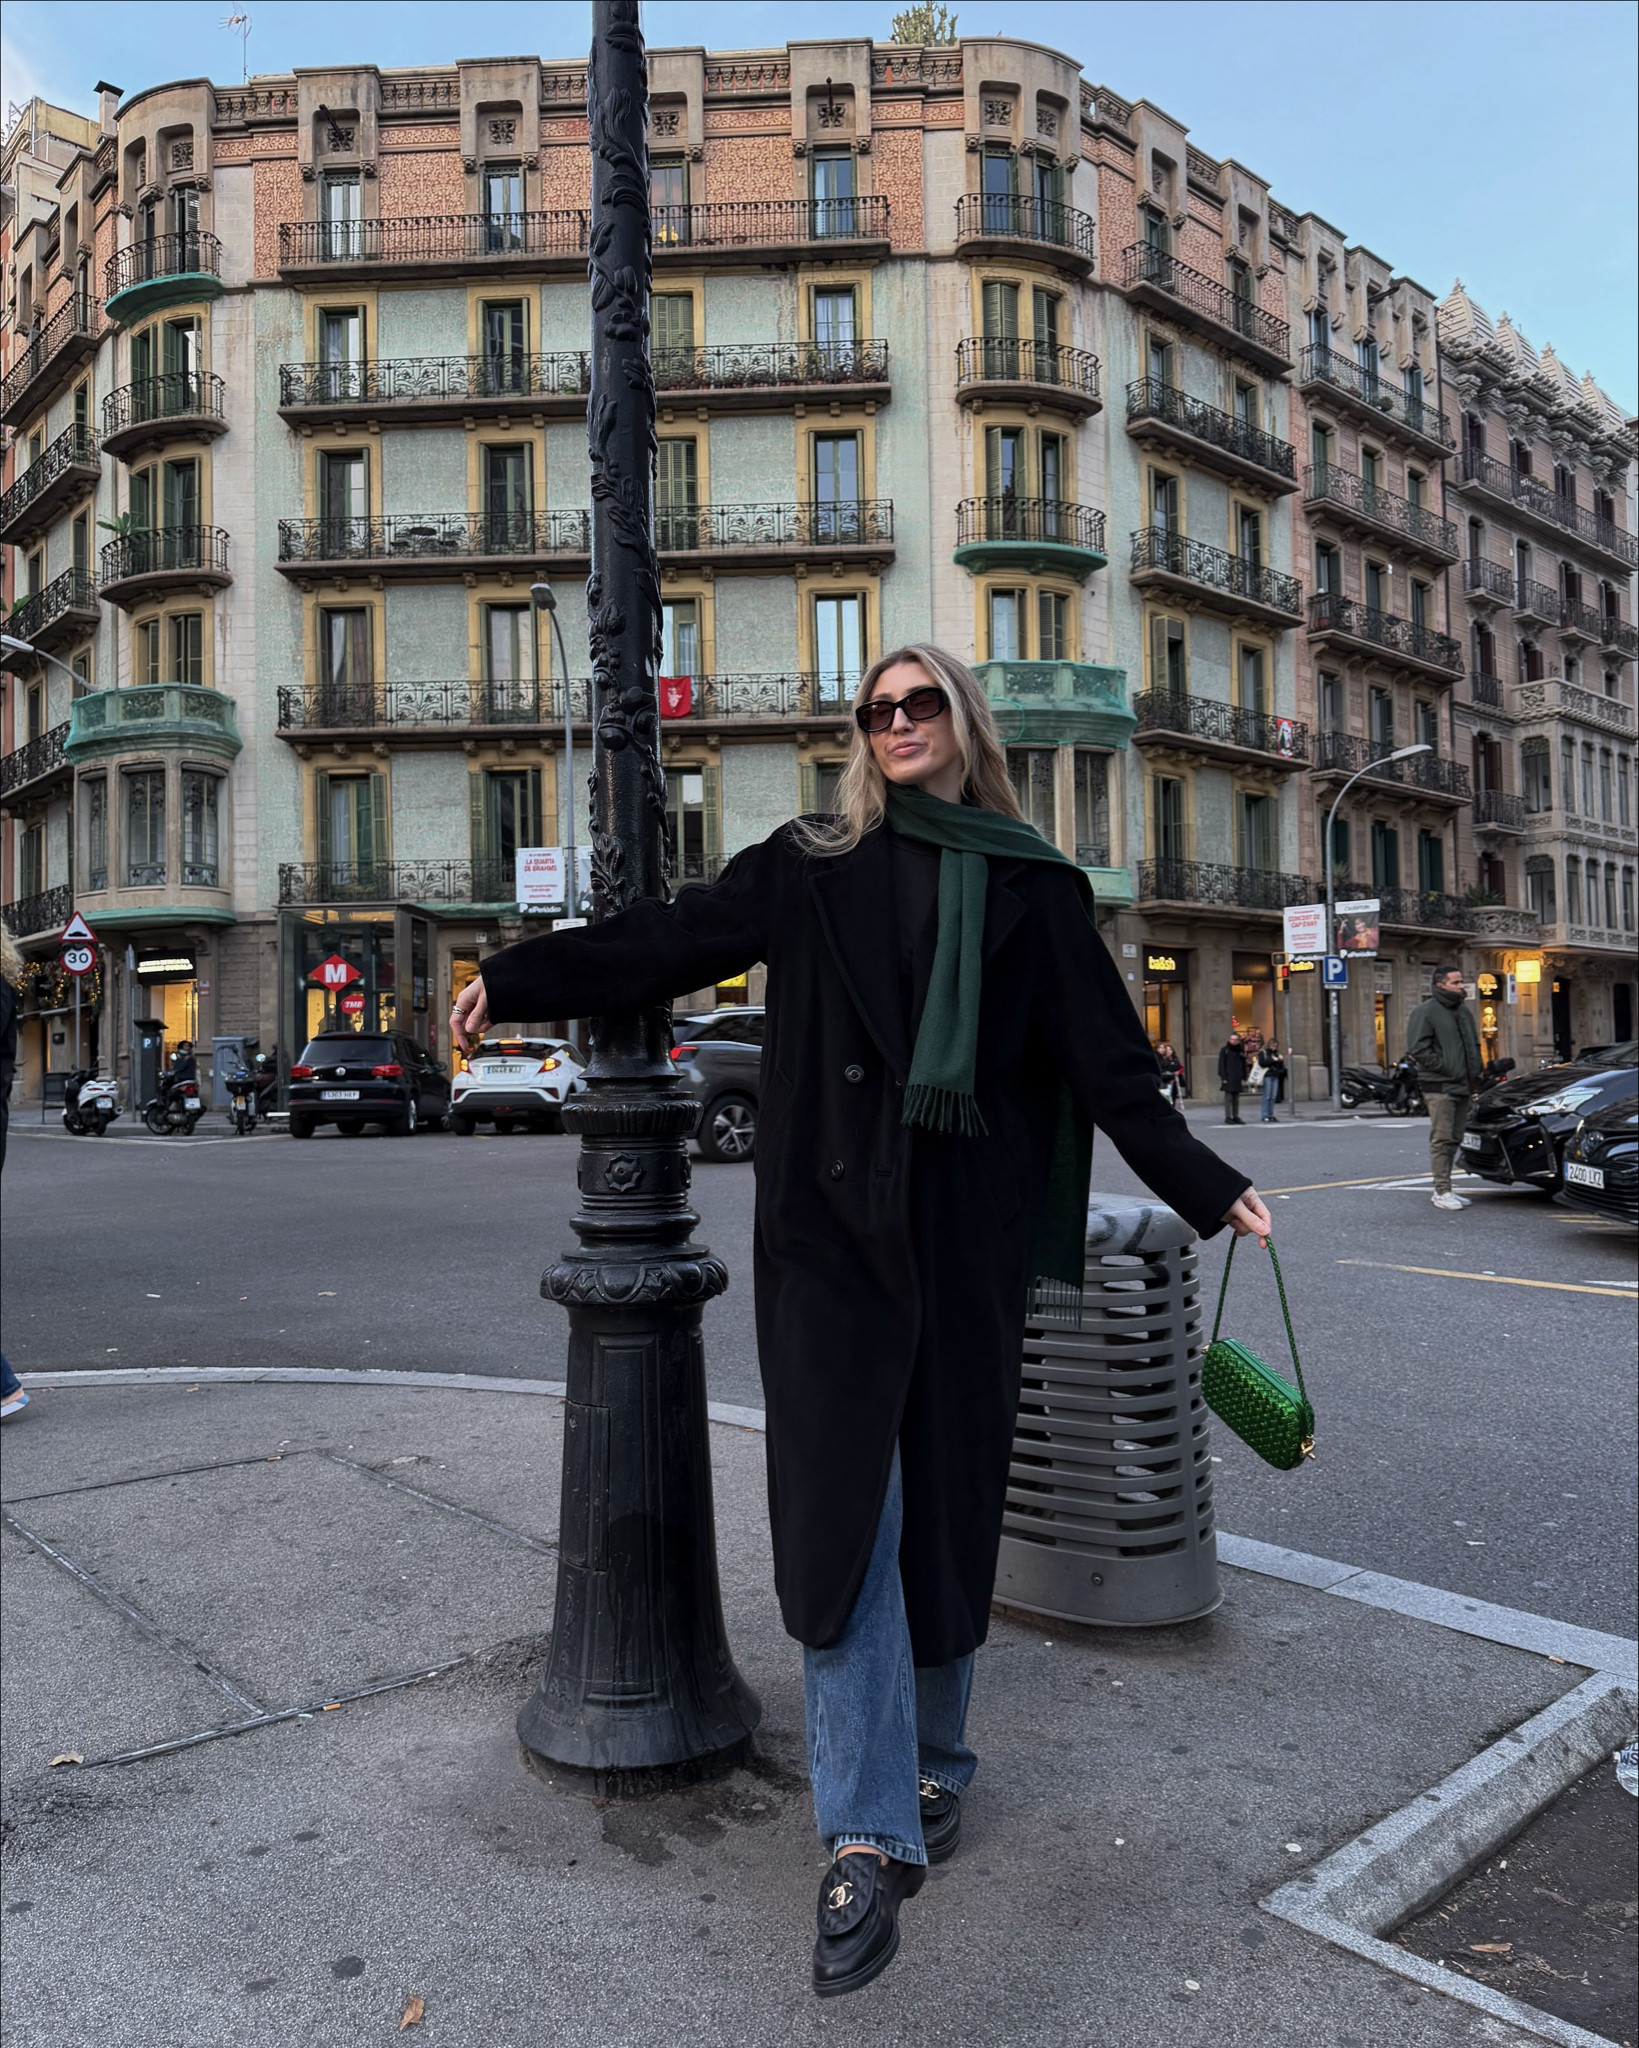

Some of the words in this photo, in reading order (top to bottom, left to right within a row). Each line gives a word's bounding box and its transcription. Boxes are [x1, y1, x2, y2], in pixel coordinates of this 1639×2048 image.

[68, 952, 89, 964] 30
[325, 963, 347, 983] M
[1328, 958, 1343, 981] P
[344, 1000, 363, 1009] TMB
[1569, 1165, 1587, 1182] 2400
